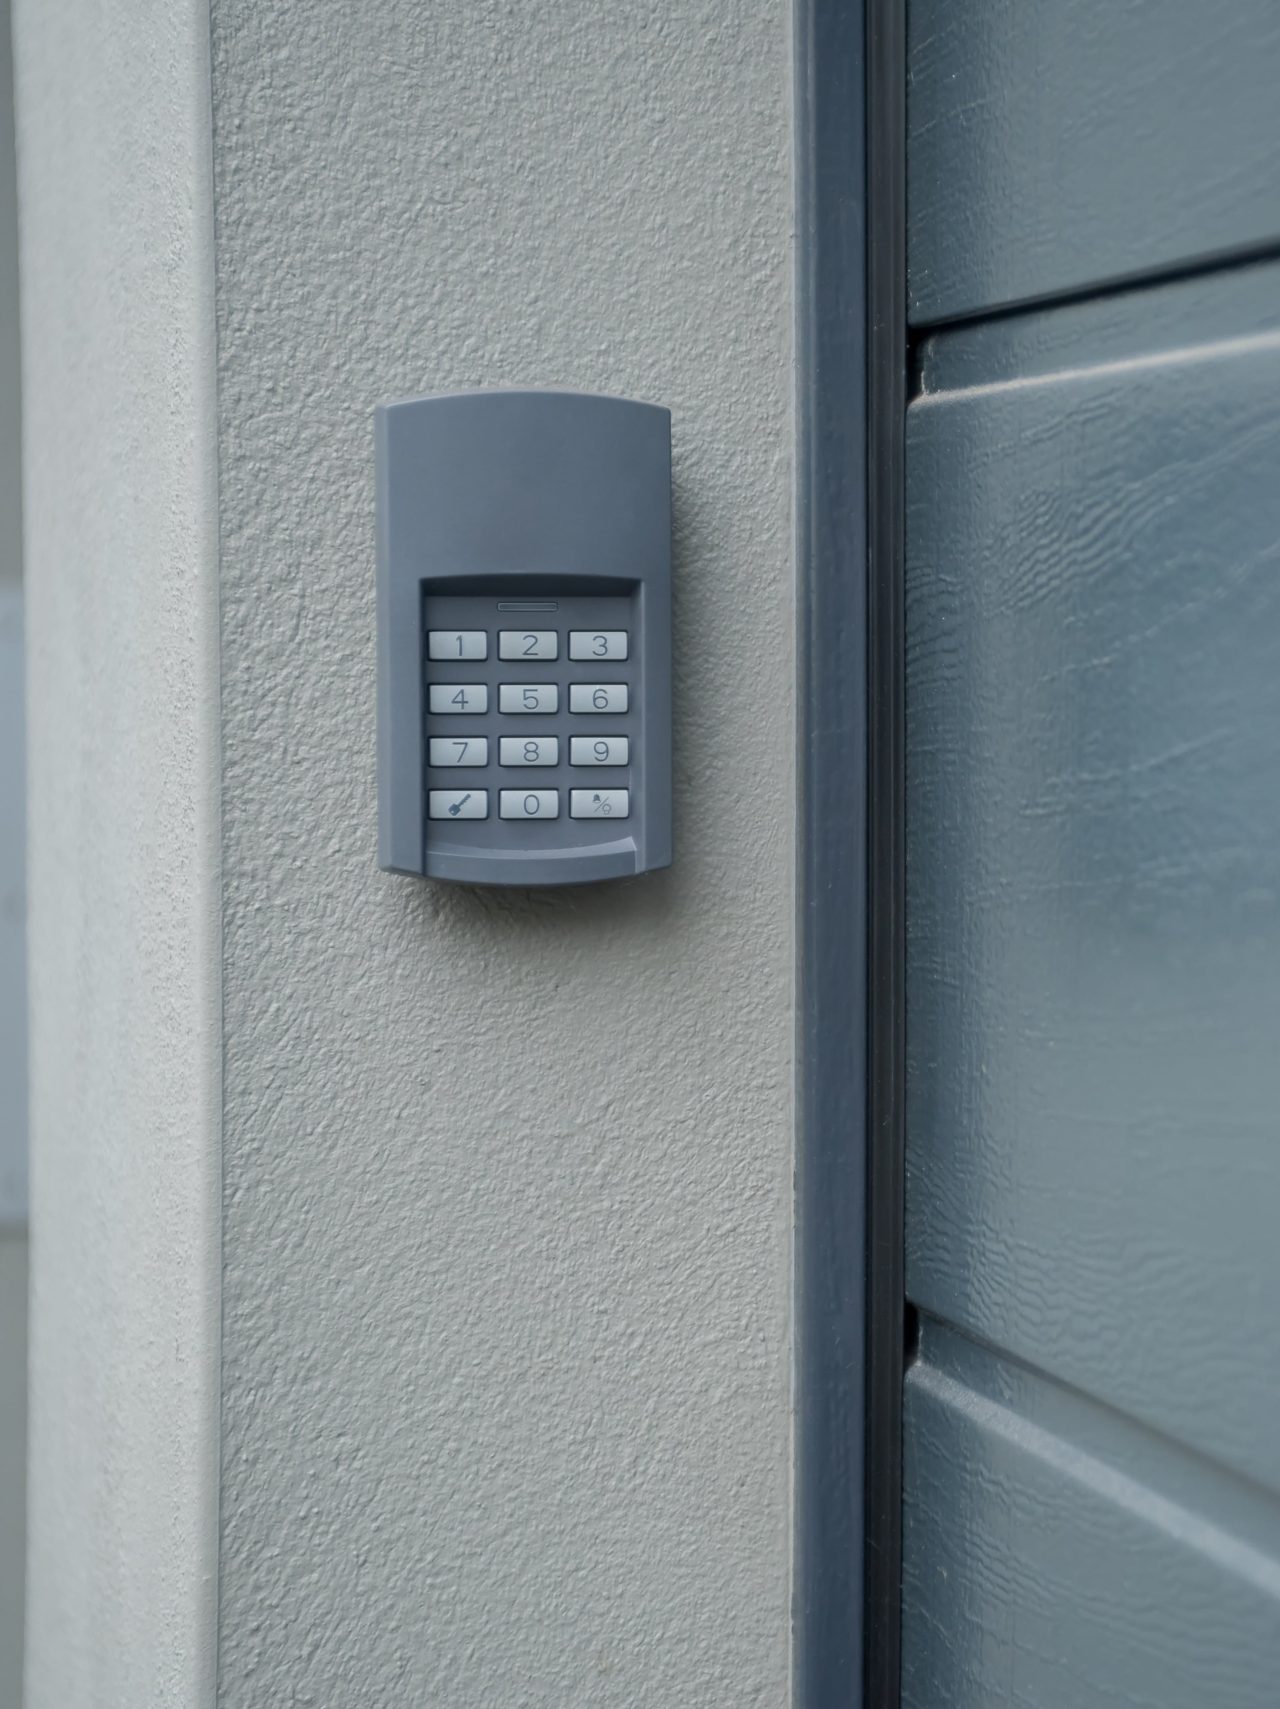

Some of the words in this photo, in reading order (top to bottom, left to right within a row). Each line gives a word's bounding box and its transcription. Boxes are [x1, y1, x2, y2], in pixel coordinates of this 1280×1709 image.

[455, 635, 463, 657] 1
[521, 634, 539, 656] 2
[592, 635, 609, 657] 3
[450, 688, 469, 711] 4
[522, 688, 540, 710] 5
[592, 688, 609, 710] 6
[452, 741, 469, 764] 7
[522, 741, 540, 763] 8
[593, 741, 610, 763] 9
[523, 794, 541, 816] 0
